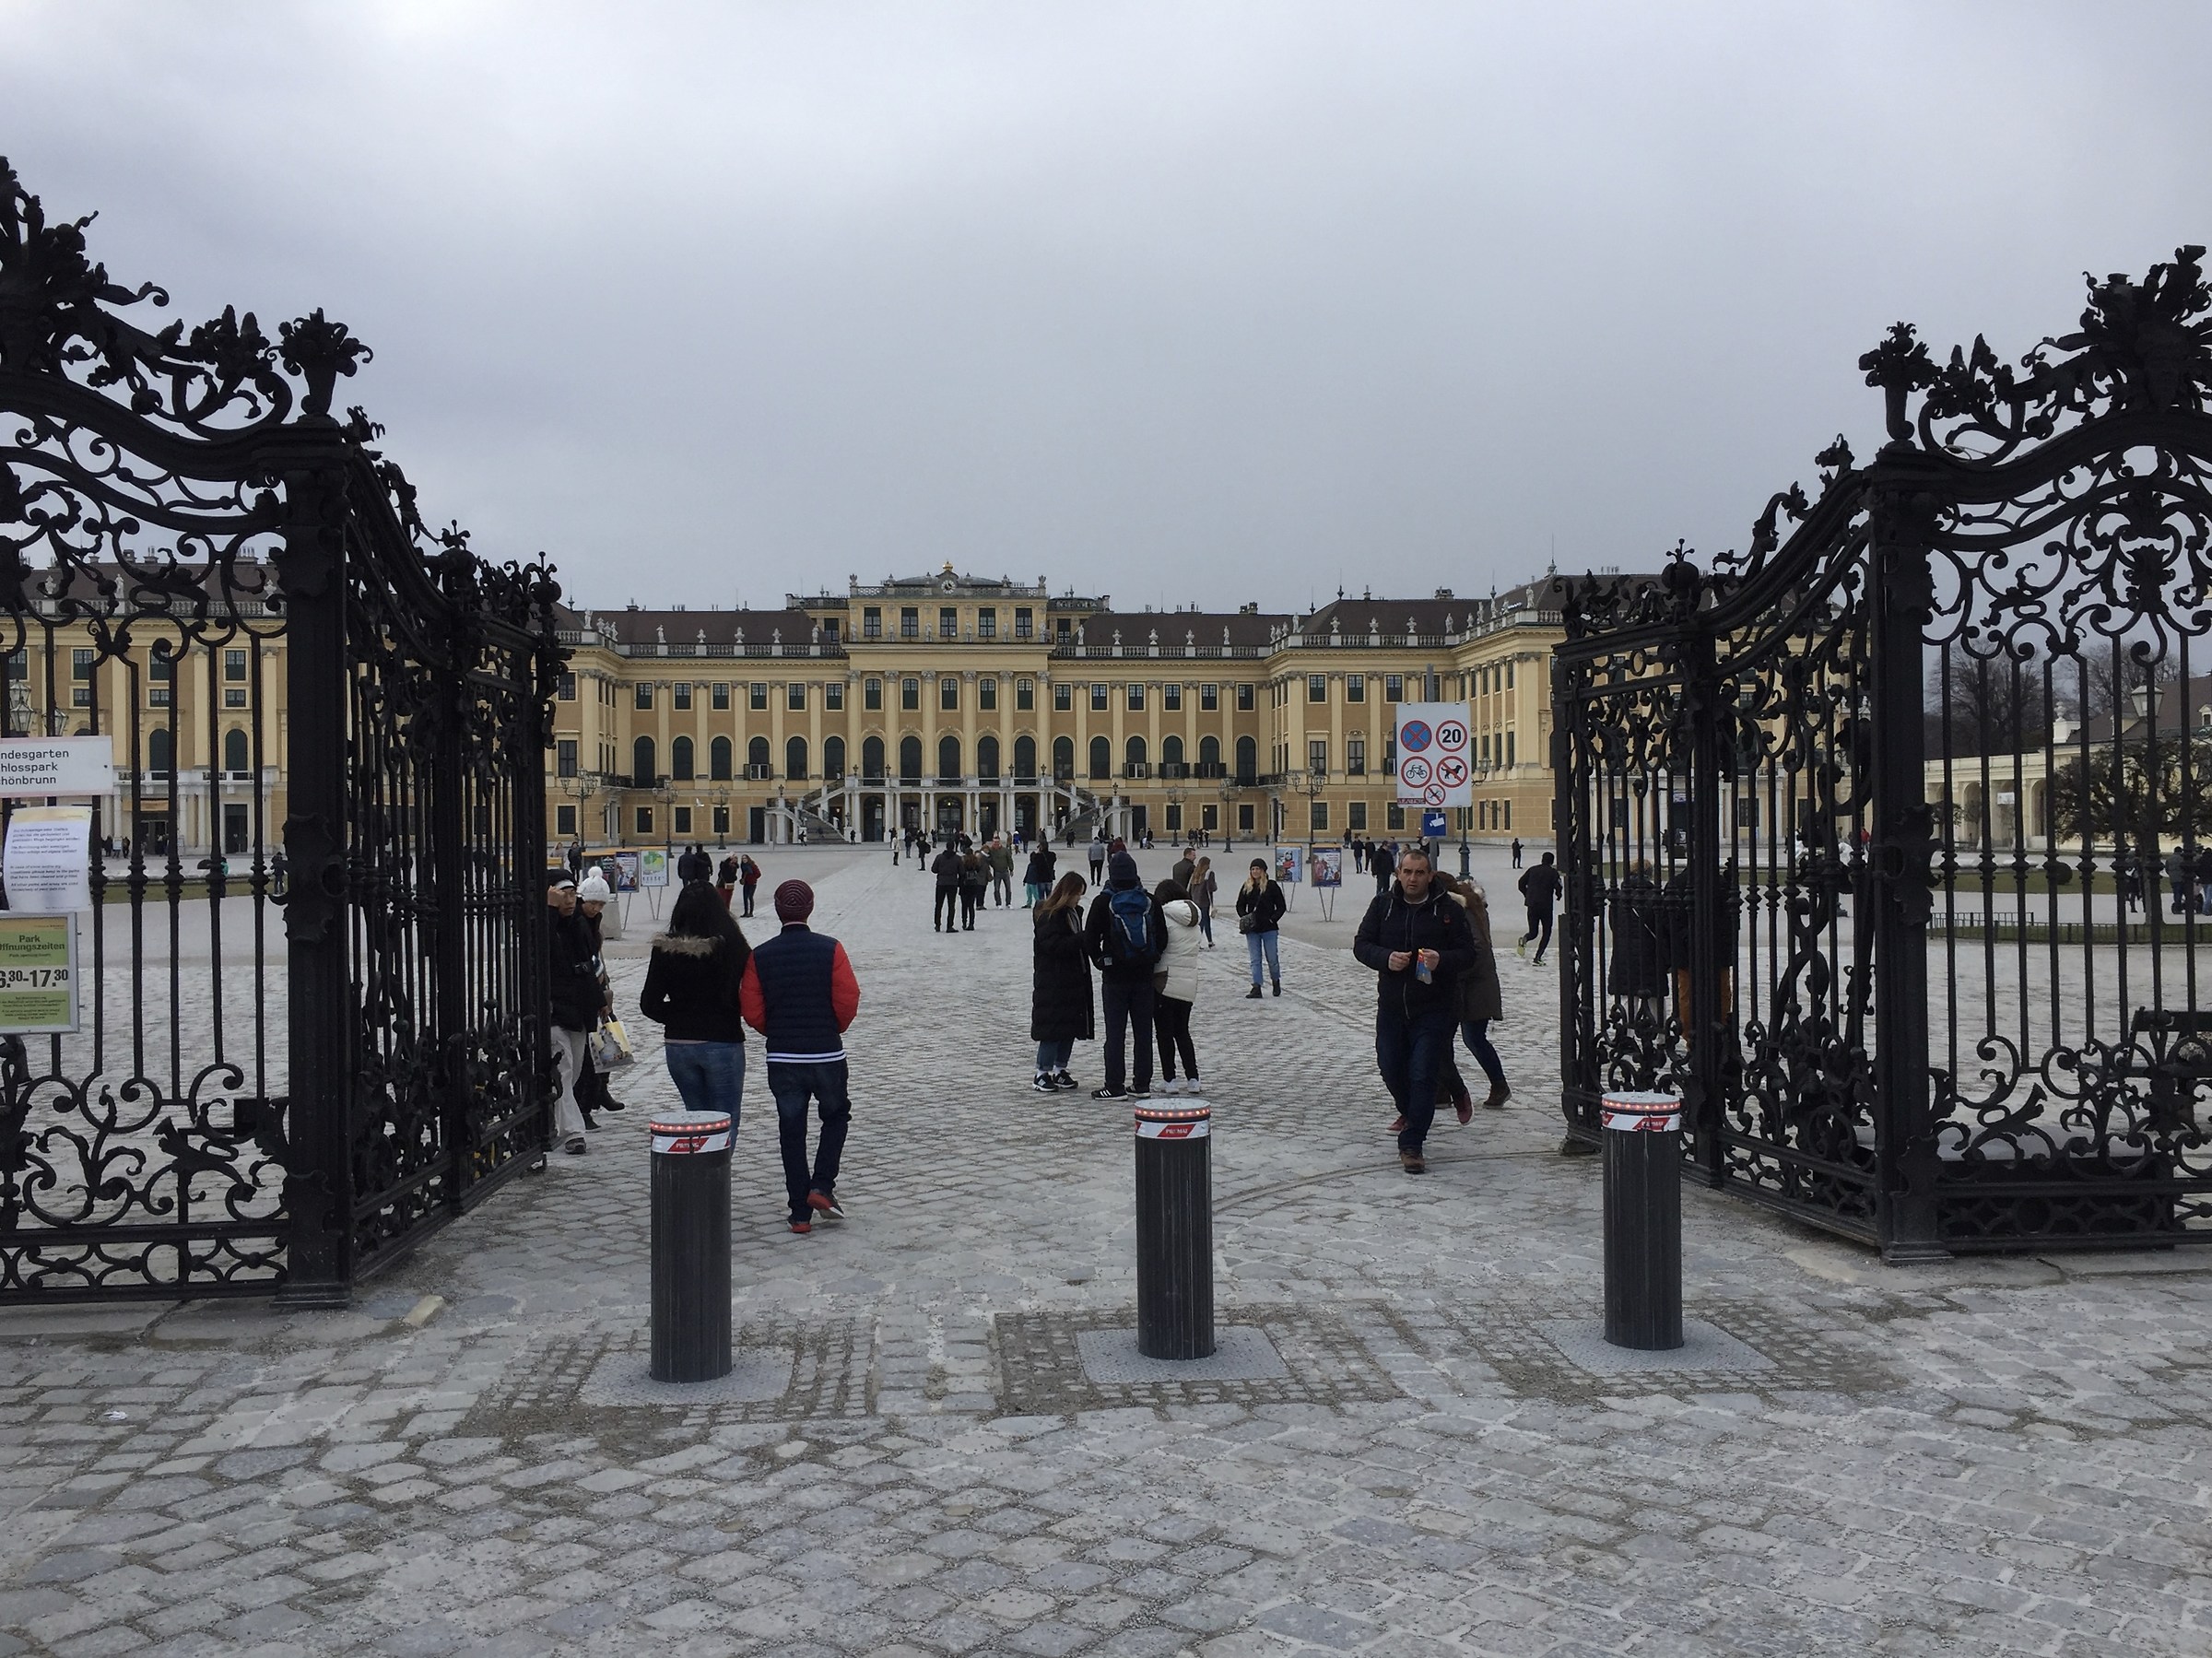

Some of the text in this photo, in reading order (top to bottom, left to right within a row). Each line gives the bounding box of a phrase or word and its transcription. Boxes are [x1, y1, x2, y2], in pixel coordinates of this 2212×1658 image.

[1441, 728, 1462, 744] 20
[0, 748, 69, 761] ndesgarten
[0, 761, 58, 773] hlosspark
[1, 775, 56, 785] hönbrunn
[18, 935, 41, 943] Park
[0, 942, 65, 952] ffnungszeiten
